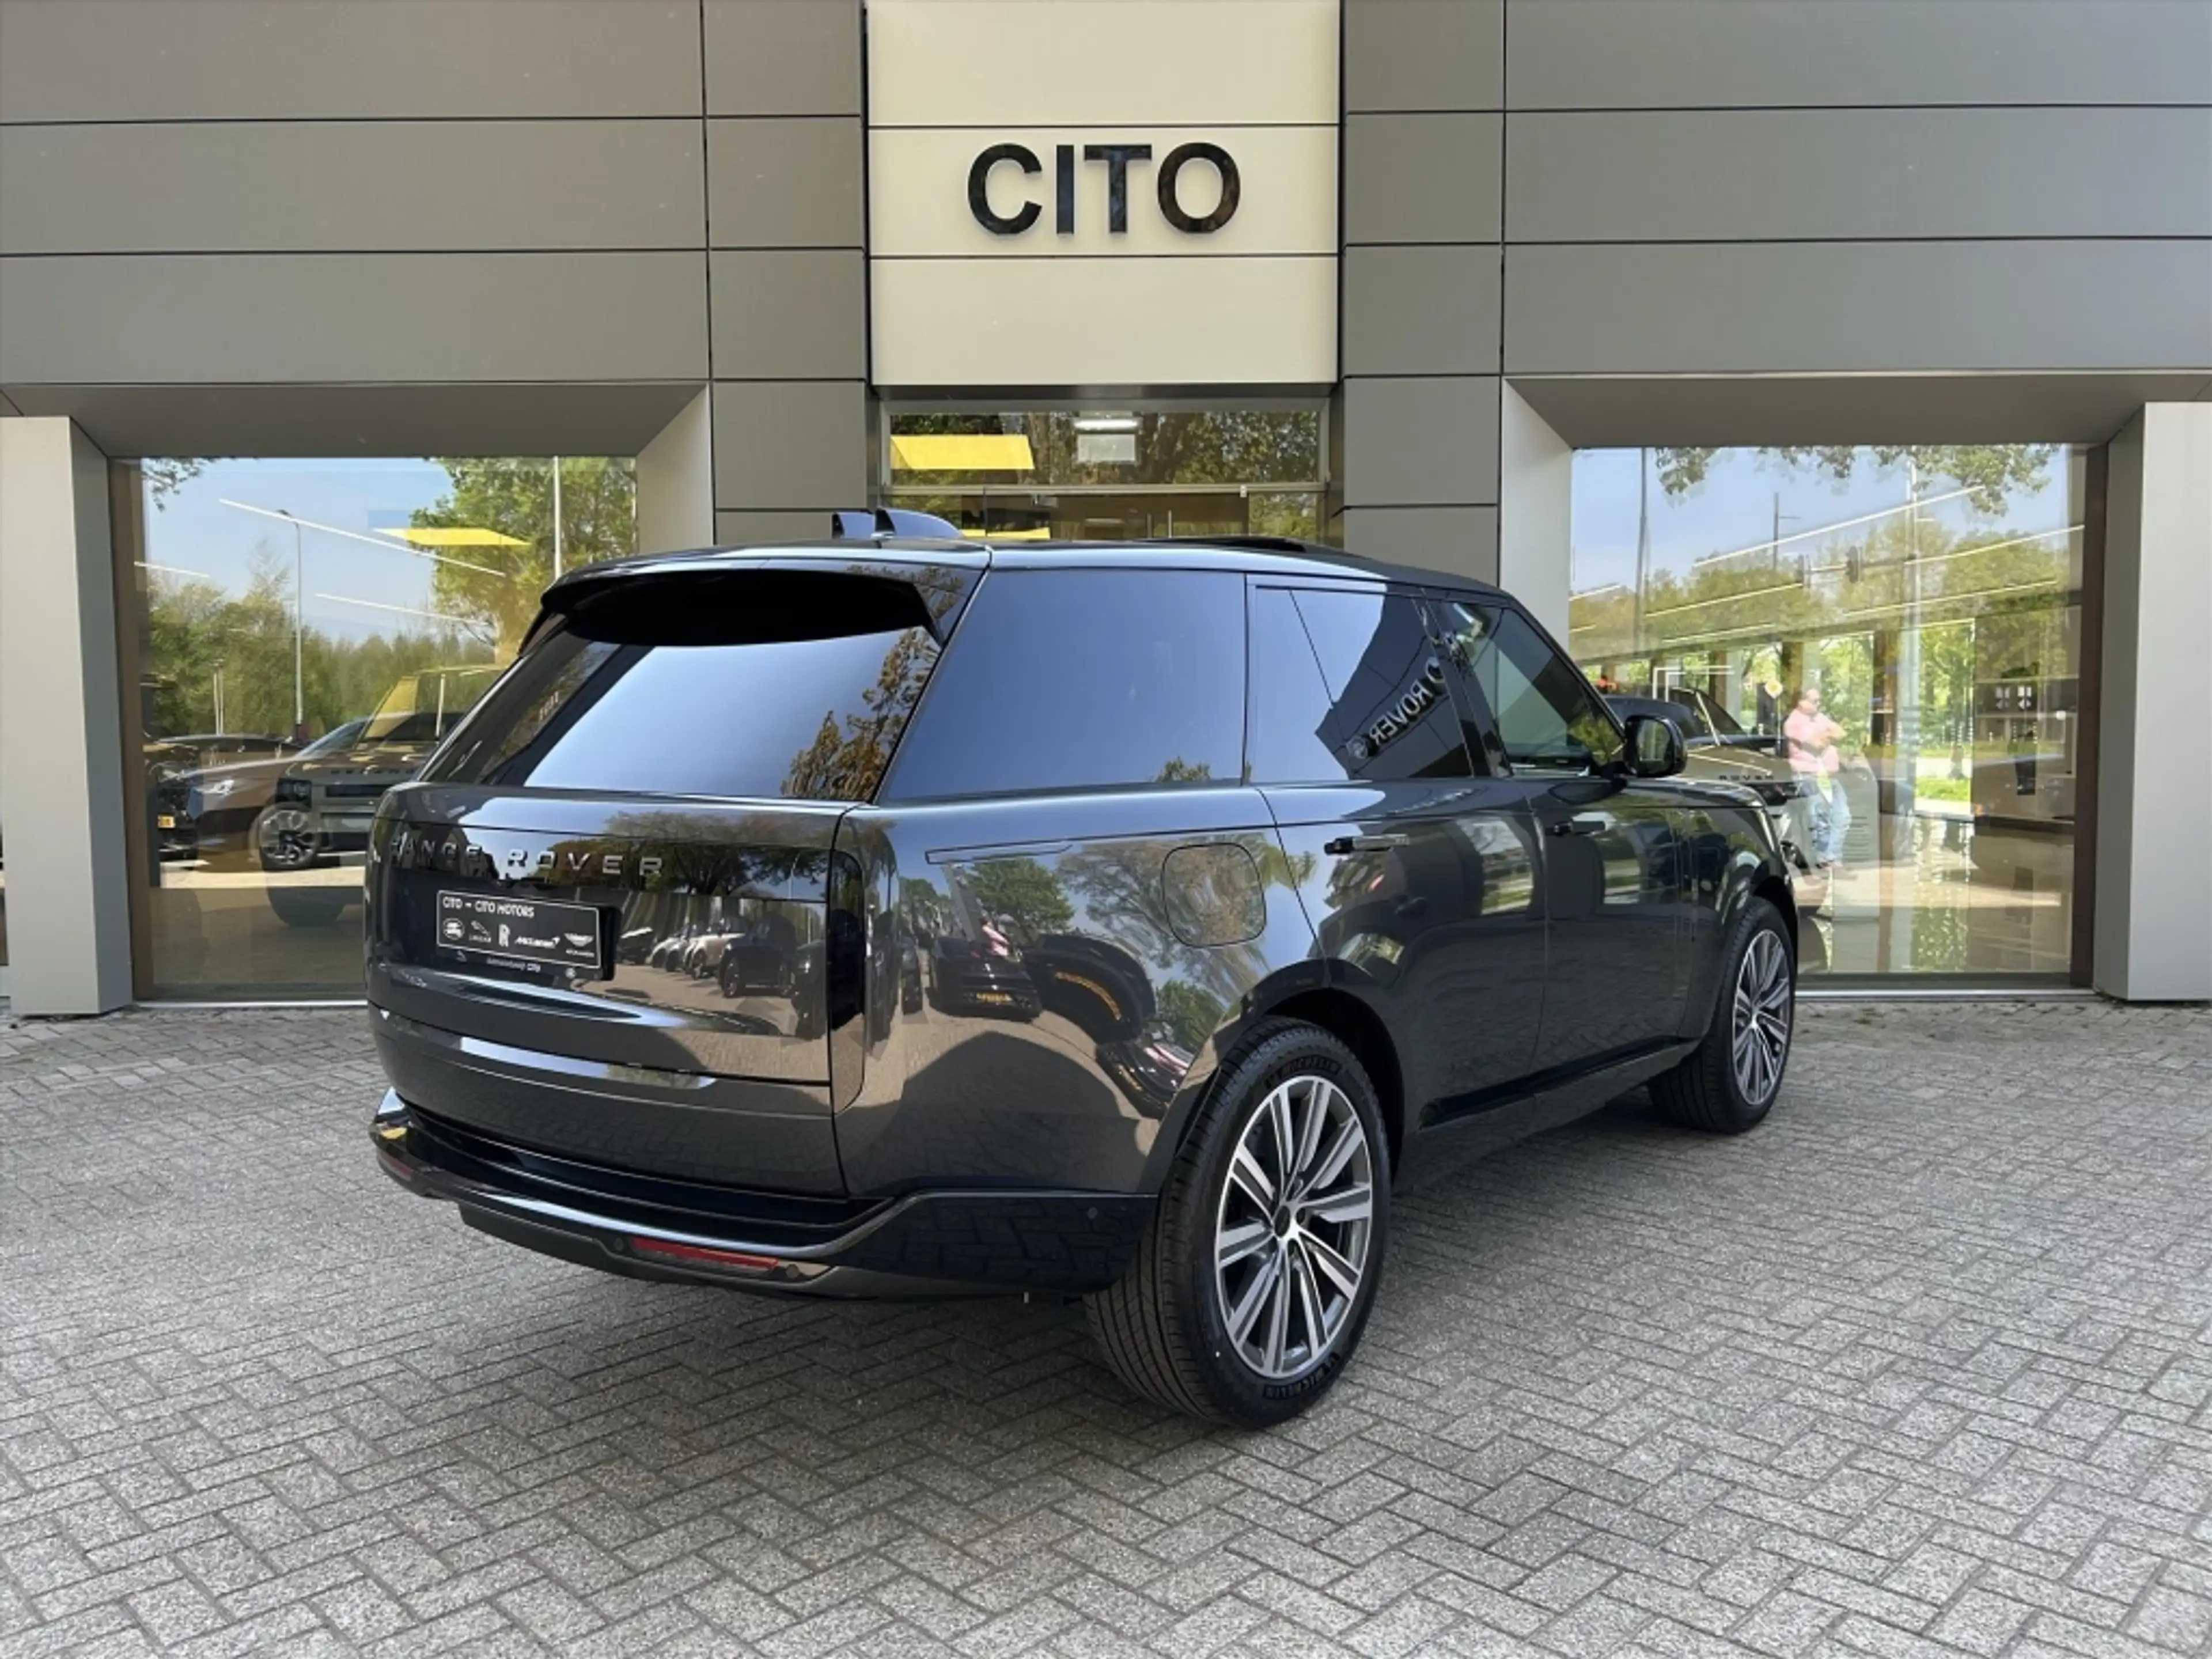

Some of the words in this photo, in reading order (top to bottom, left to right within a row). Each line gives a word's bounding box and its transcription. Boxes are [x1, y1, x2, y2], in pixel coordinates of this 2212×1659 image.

[968, 142, 1240, 234] CITO
[507, 848, 662, 877] ROVER
[442, 896, 463, 910] CITO
[475, 900, 495, 914] CITO
[497, 903, 535, 919] MOTORS
